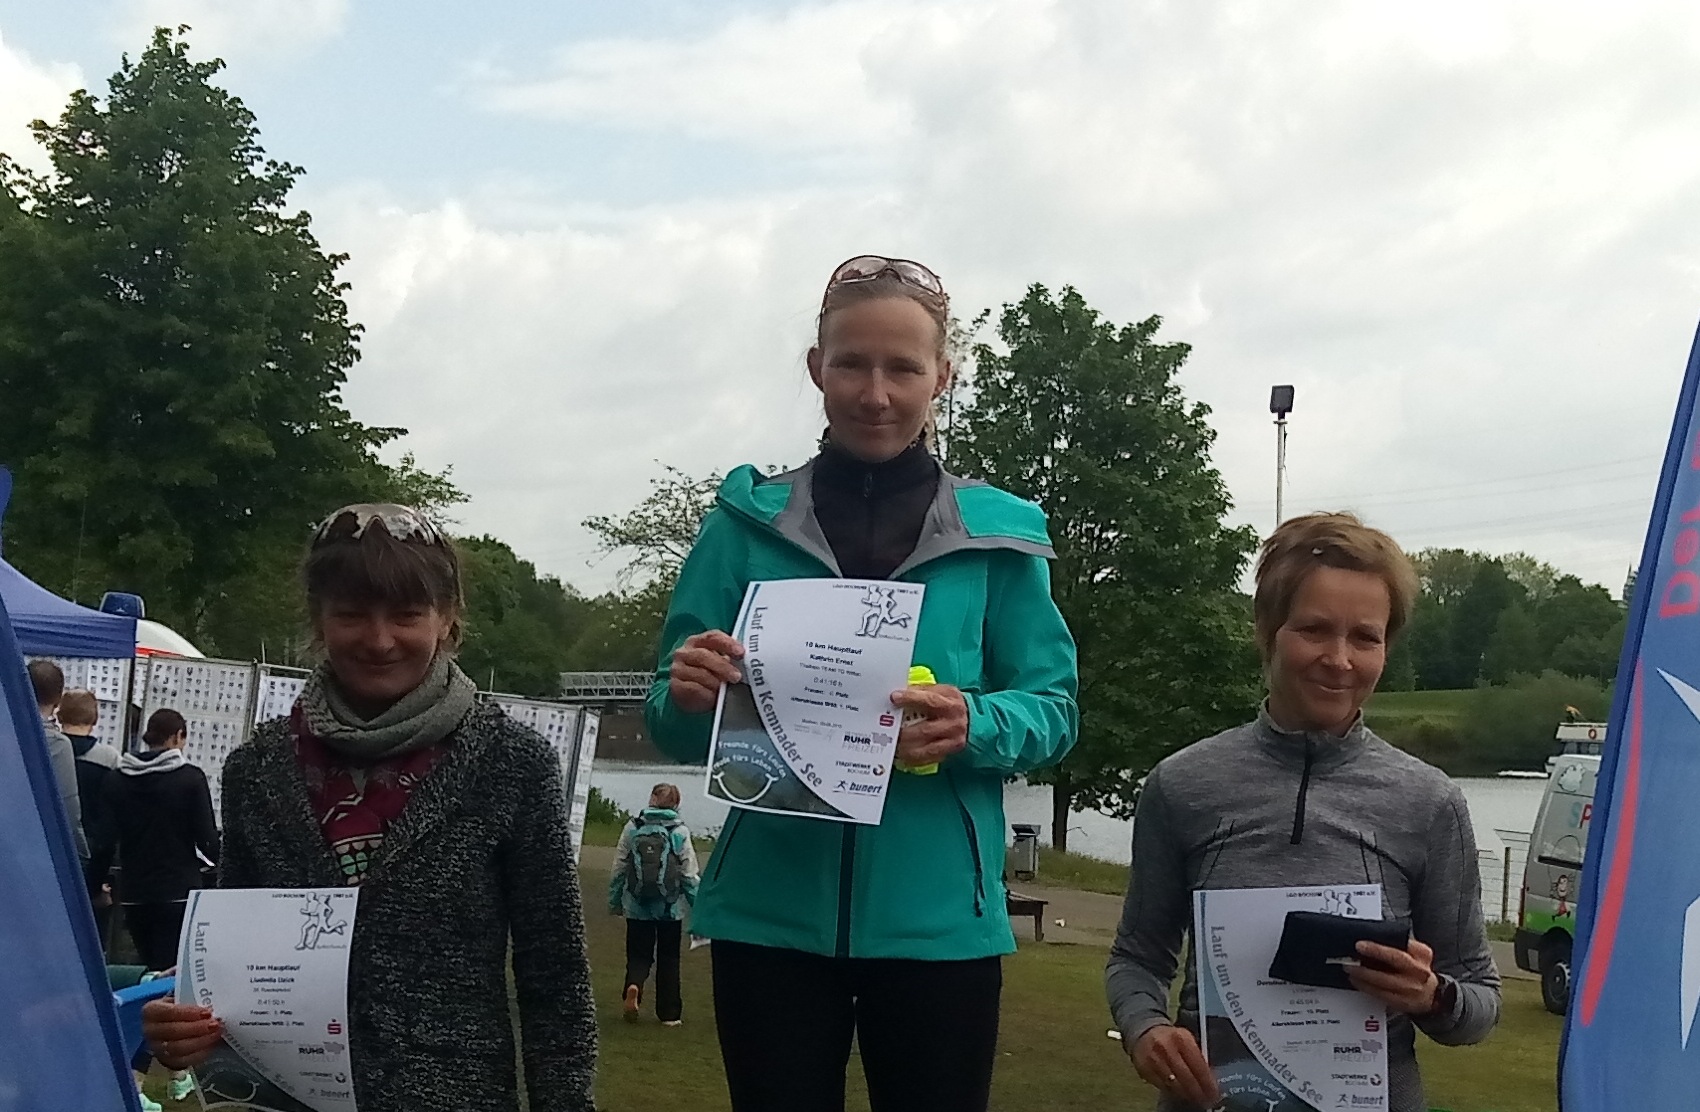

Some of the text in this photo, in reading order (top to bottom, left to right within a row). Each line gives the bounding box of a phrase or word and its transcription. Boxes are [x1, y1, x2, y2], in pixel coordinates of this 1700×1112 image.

[749, 606, 823, 787] Lauf um den Kemnader See
[843, 735, 871, 746] RUHR
[849, 780, 883, 794] bunert
[194, 921, 210, 954] Lauf
[195, 959, 207, 983] um
[1210, 926, 1323, 1104] Lauf um den Kemnader See
[298, 1047, 325, 1055] RUHR
[1333, 1046, 1362, 1054] RUHR
[1351, 1093, 1383, 1106] bunert
